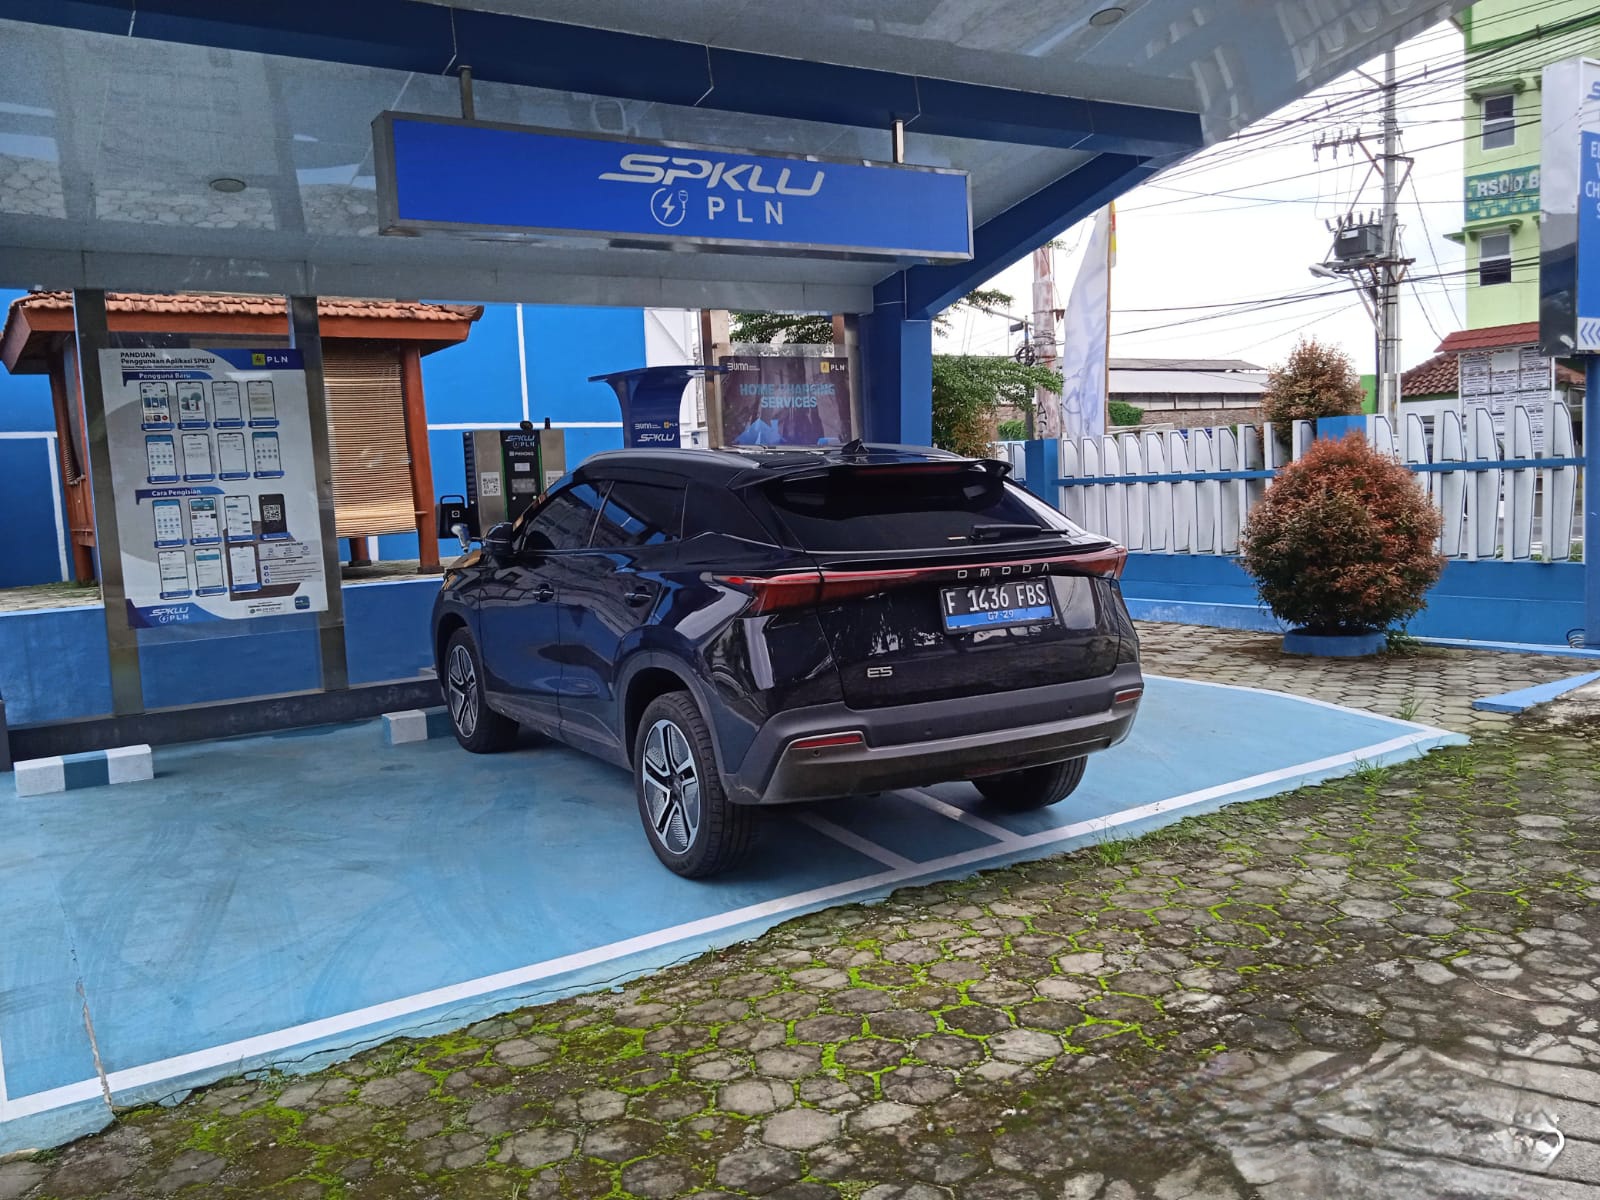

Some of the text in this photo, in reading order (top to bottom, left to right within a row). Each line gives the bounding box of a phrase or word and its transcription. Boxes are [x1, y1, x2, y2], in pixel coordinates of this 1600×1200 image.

[598, 153, 825, 197] SPKLU
[707, 196, 785, 225] PLN
[740, 384, 775, 395] HOME
[761, 396, 818, 408] SERVICES
[637, 433, 675, 442] SPKLU
[168, 488, 202, 496] Pengisian
[946, 584, 1046, 613] F 1436 FBS
[149, 606, 190, 617] SPKLU
[169, 613, 190, 622] PLN
[867, 666, 893, 678] E5
